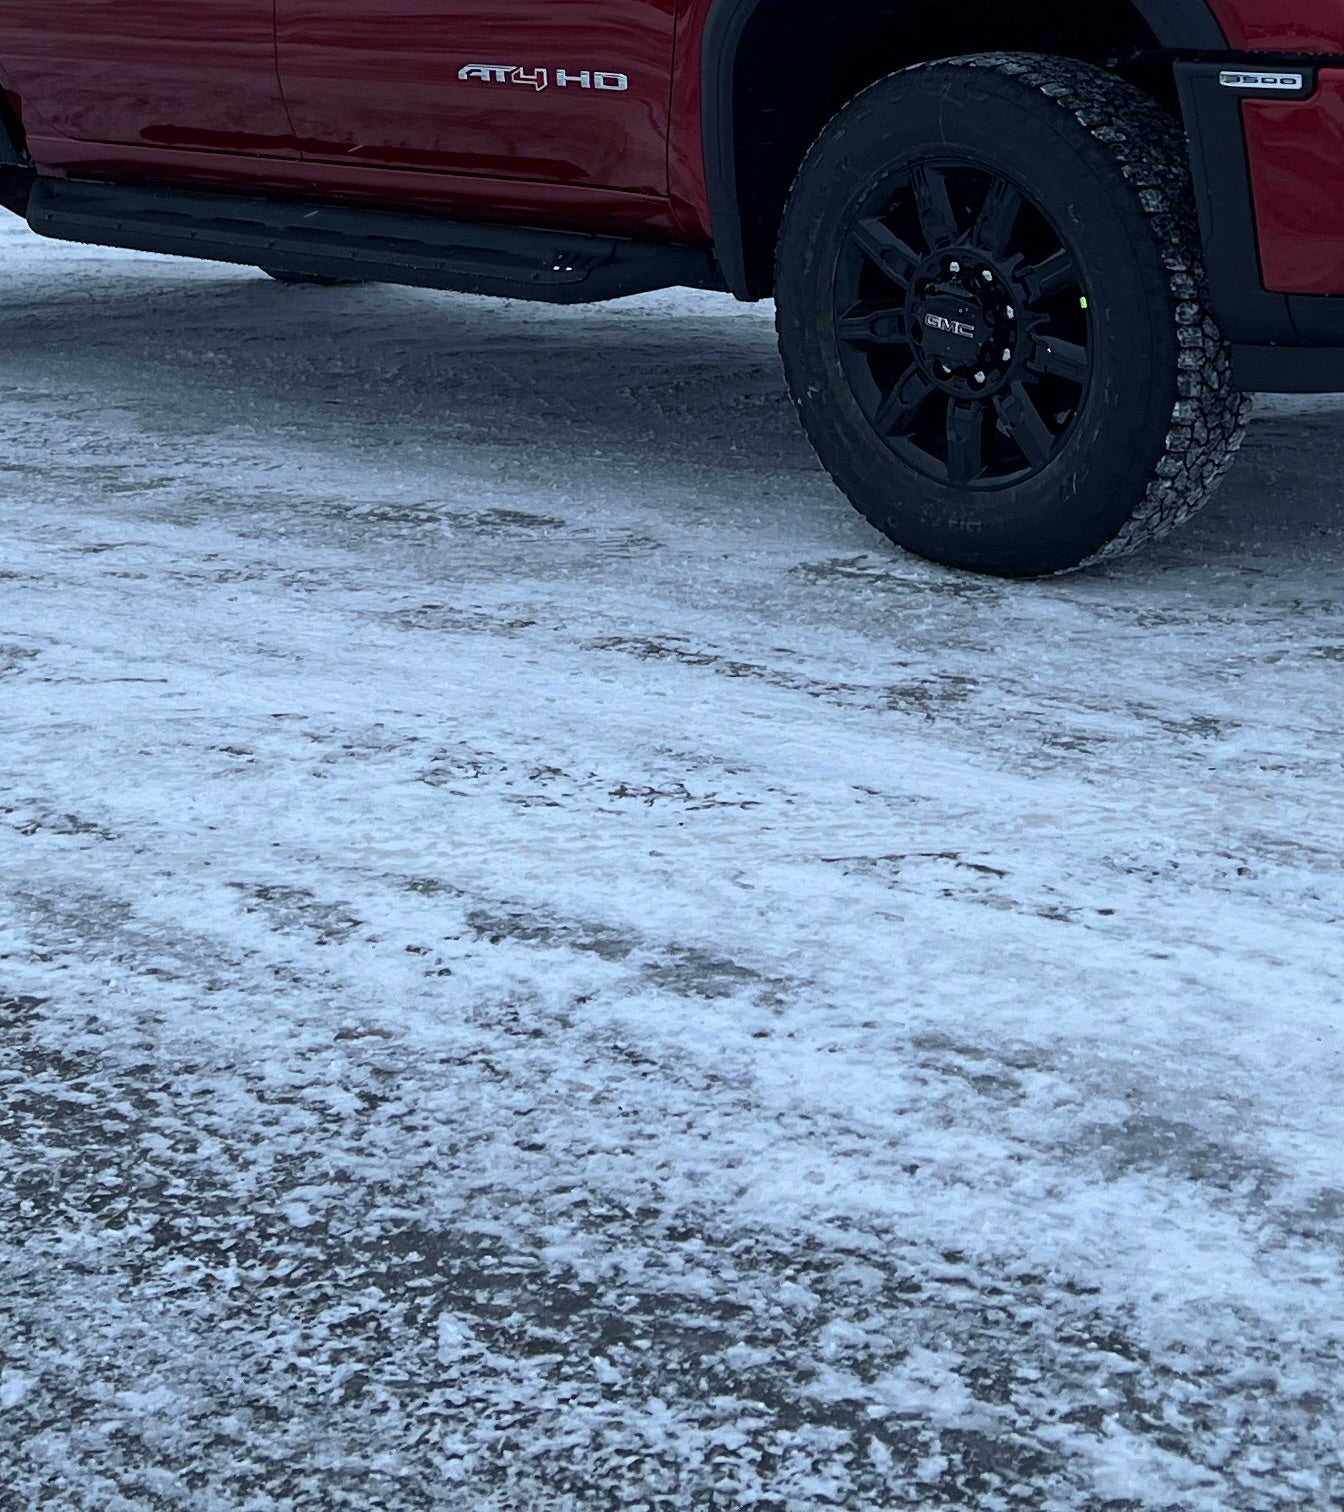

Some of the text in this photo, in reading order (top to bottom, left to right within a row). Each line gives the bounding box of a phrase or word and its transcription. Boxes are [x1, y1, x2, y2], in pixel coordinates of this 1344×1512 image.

[458, 63, 628, 92] AT4 HD
[924, 313, 975, 339] GMC
